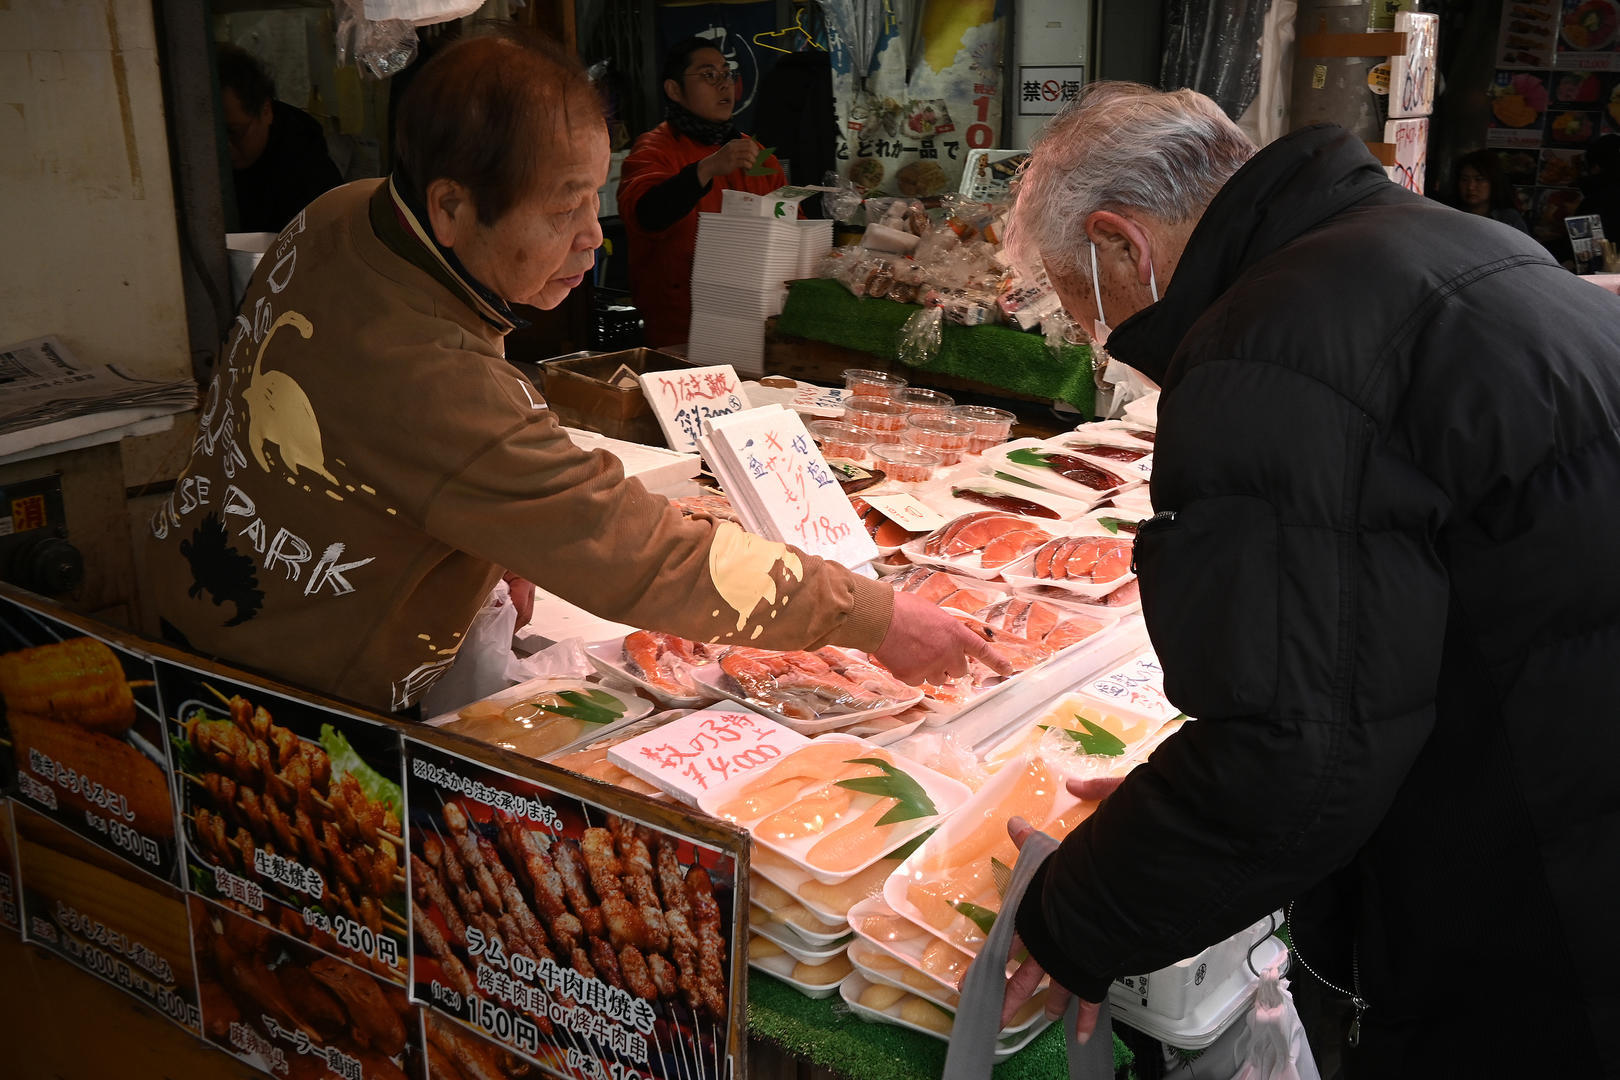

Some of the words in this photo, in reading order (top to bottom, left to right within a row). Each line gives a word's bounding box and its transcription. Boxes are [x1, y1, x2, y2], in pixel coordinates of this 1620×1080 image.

[1023, 80, 1080, 102] 禁煙
[221, 484, 377, 597] PARK
[412, 757, 565, 832] ※2本から注文承ります。
[334, 913, 400, 968] 250円
[465, 925, 509, 970] ラム
[509, 952, 537, 982] or
[537, 956, 658, 1037] 牛肉串焼き
[476, 964, 550, 1018] 烤羊肉串
[549, 1001, 574, 1029] or
[572, 1008, 650, 1065] 烤牛肉串
[466, 994, 540, 1054] 150円
